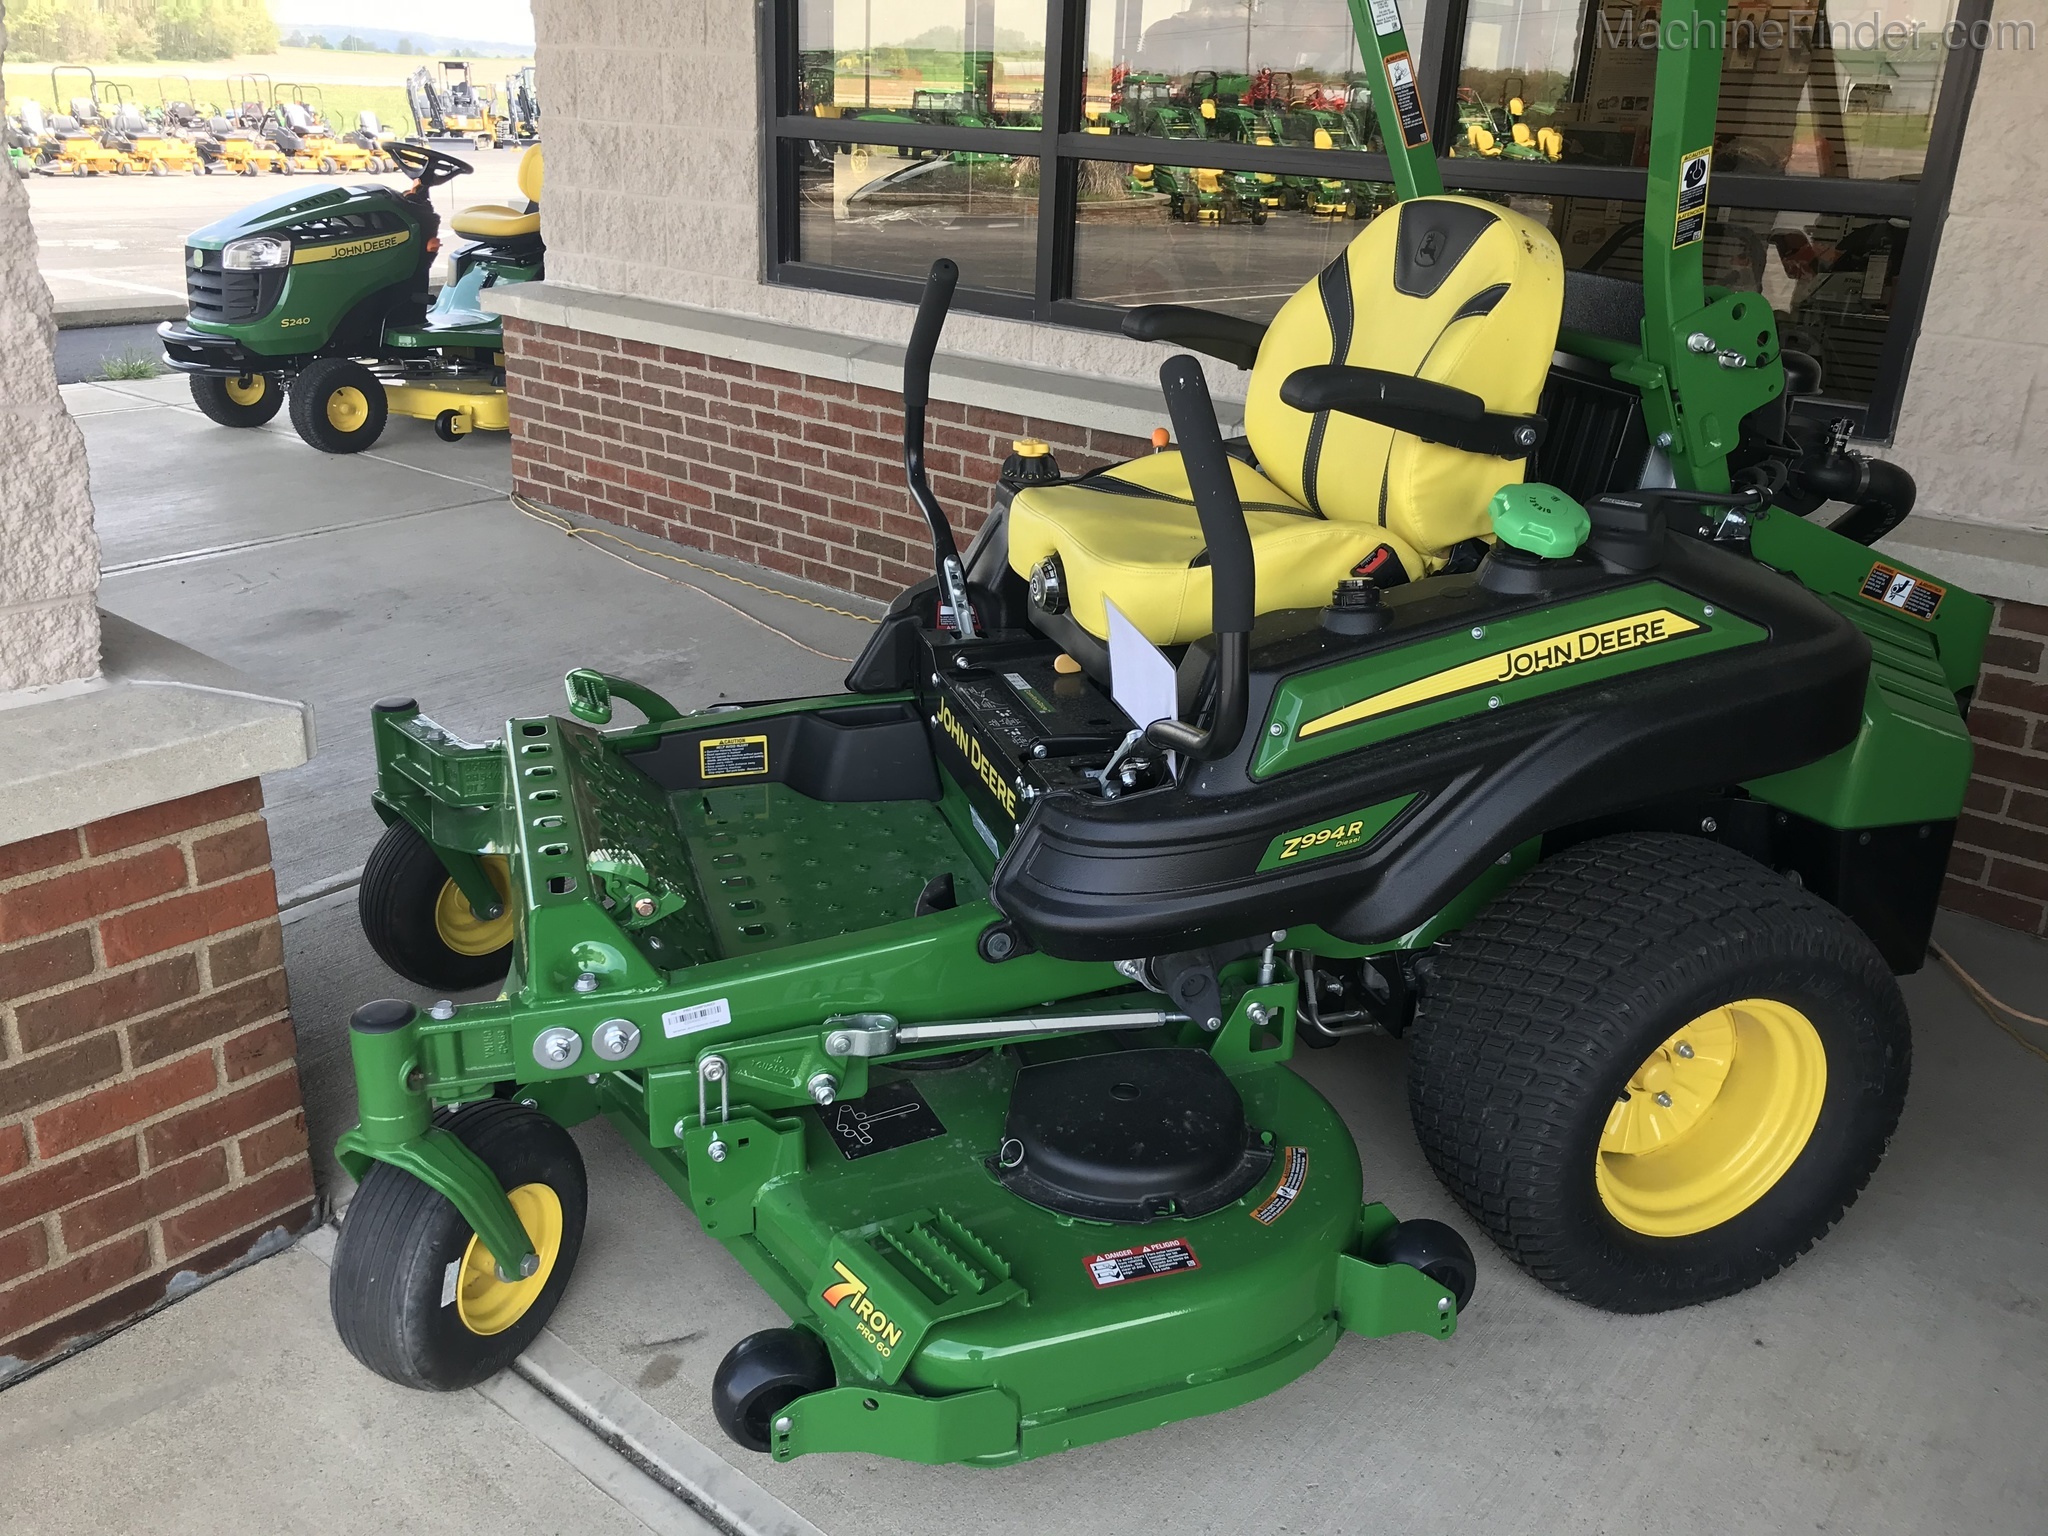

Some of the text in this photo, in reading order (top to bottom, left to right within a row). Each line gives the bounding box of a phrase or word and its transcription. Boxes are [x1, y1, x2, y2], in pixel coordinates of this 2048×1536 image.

[331, 237, 397, 258] JOHN DEERE
[281, 317, 311, 328] S240
[1498, 618, 1666, 680] JOHN DEERE
[936, 696, 969, 758] JOHN
[971, 736, 1017, 820] DEERE
[1280, 821, 1364, 859] Z994R
[1335, 836, 1361, 848] Diesel
[1104, 1249, 1133, 1260] DANGER
[1150, 1239, 1180, 1251] PELIGRO
[856, 1322, 891, 1357] PRO 60
